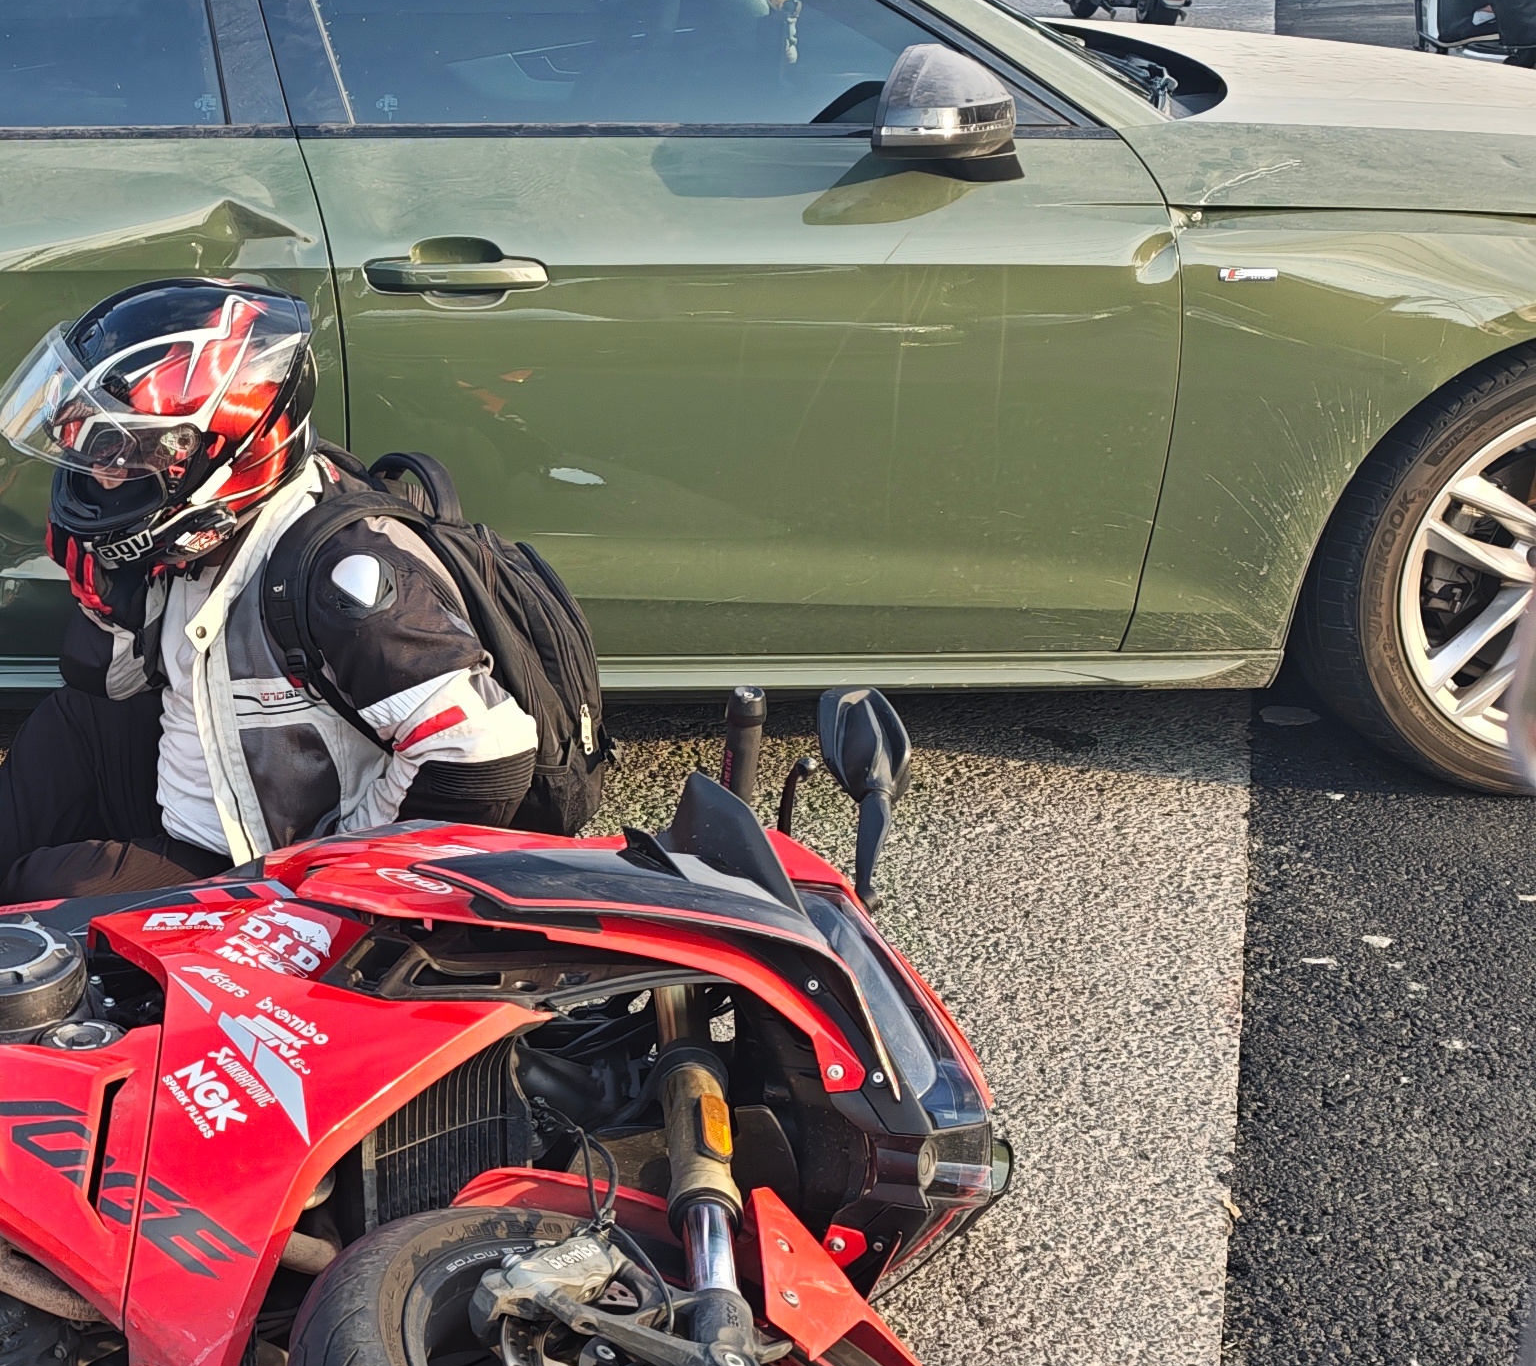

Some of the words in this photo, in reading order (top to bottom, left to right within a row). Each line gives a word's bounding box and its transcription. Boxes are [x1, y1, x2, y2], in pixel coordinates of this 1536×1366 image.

[100, 530, 153, 561] agv
[145, 911, 234, 927] RK
[255, 997, 329, 1045] brembo
[161, 1074, 192, 1106] SPARK
[184, 1104, 215, 1140] PLUGS
[173, 1059, 248, 1132] NGK
[445, 1249, 499, 1273] MOTOS
[544, 1243, 602, 1270] brembo
